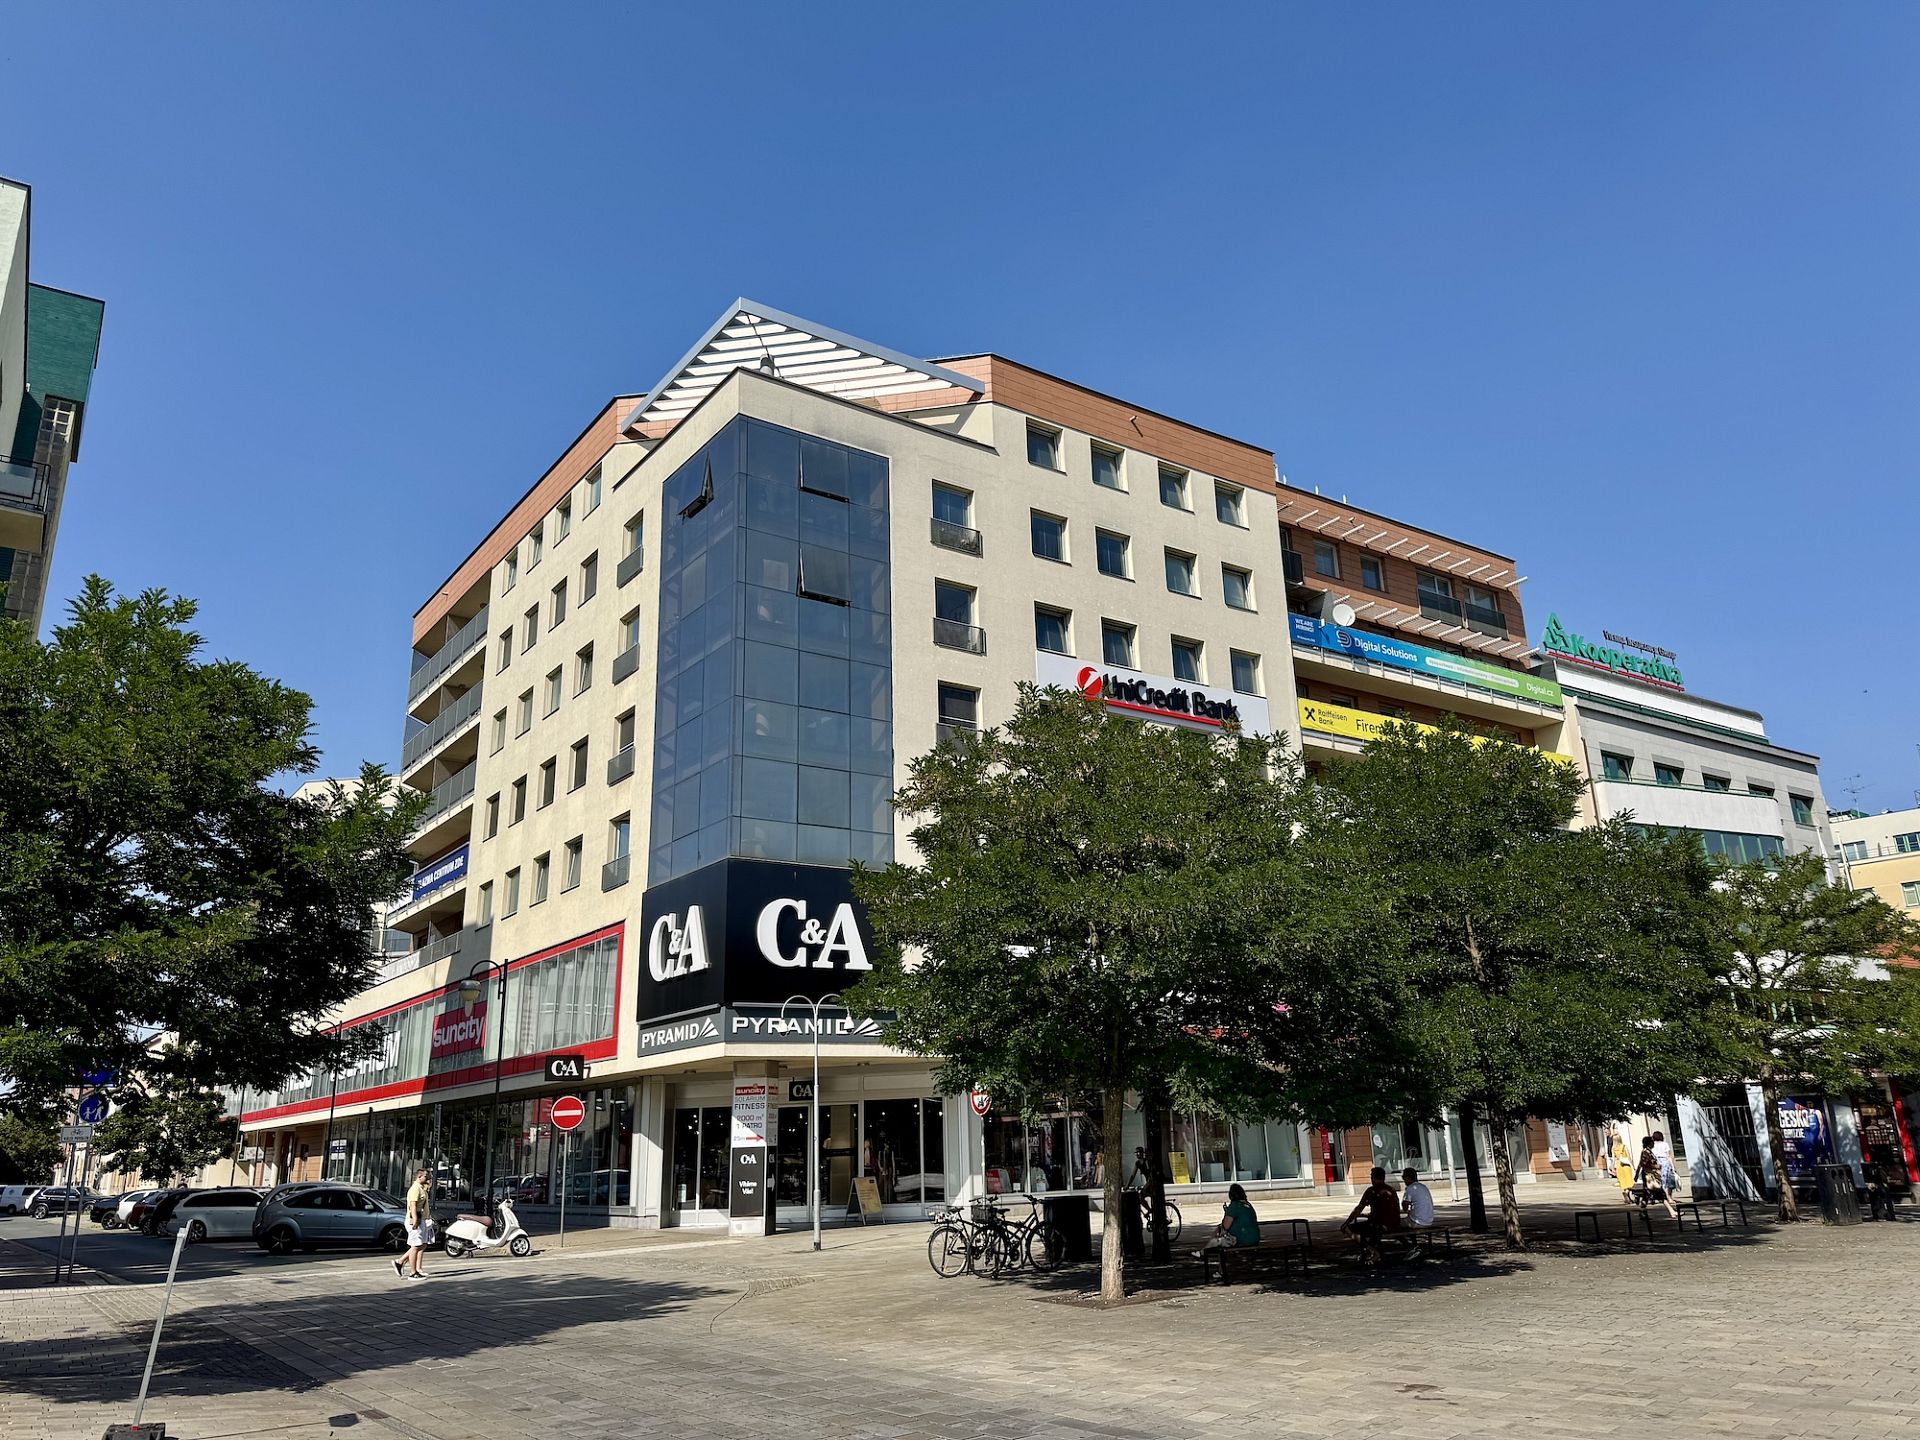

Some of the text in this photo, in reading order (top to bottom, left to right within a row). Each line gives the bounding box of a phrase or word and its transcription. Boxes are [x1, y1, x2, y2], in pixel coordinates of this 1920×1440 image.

[1353, 636, 1418, 662] Digital Solutions
[1570, 633, 1684, 685] Kooperativa
[1102, 673, 1240, 723] UniCredit Bank
[1317, 708, 1348, 722] Raiffeisen
[1318, 716, 1334, 726] Bank
[649, 903, 712, 983] C&A
[756, 897, 874, 970] C&A
[433, 1015, 485, 1048] suncity
[641, 1021, 700, 1049] PYRAMID
[551, 1059, 579, 1077] C&A
[734, 1095, 766, 1103] SOLARIUM
[734, 1102, 766, 1110] FITNESS
